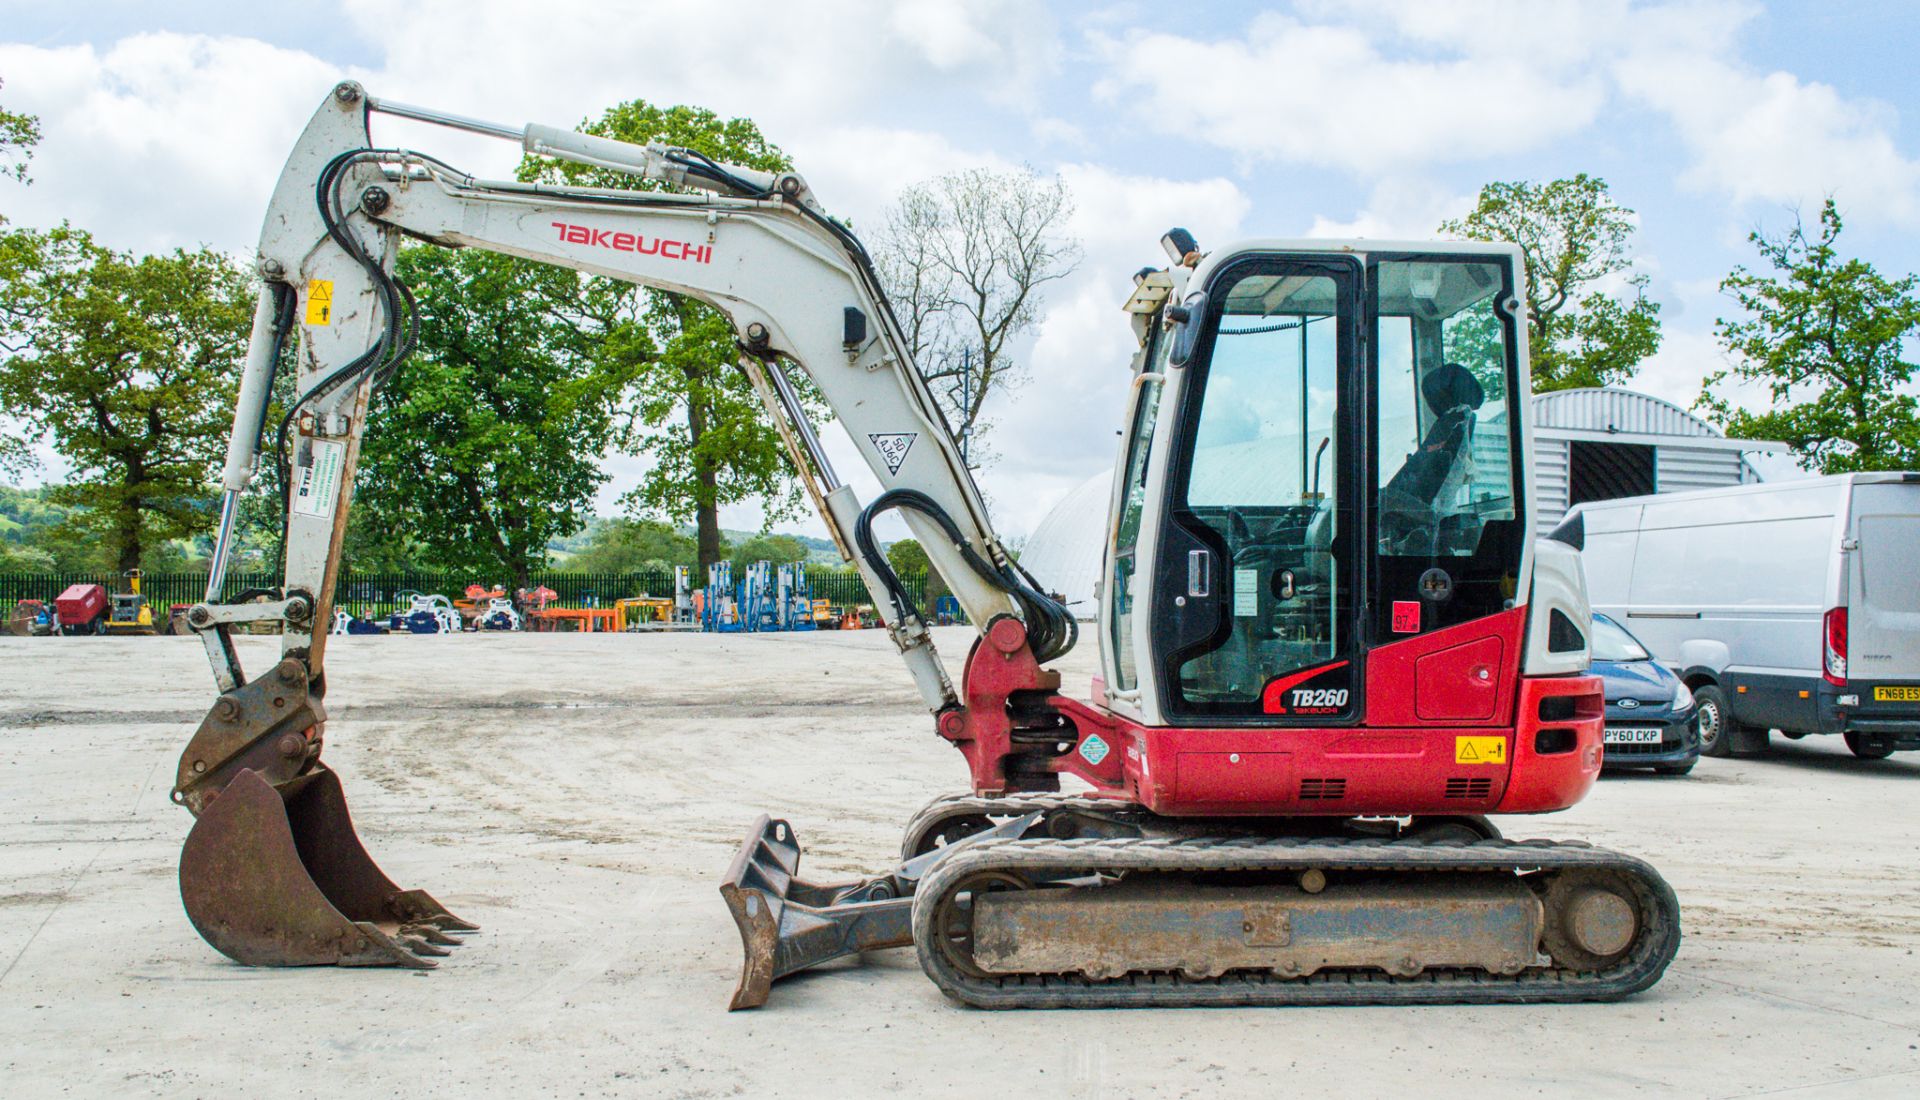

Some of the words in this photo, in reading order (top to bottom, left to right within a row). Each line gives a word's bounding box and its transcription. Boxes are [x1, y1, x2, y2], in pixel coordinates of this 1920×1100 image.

[1292, 688, 1349, 707] TB260
[1878, 688, 1905, 699] FN68
[1906, 688, 1920, 699] ES
[1604, 730, 1634, 742] PY60
[1636, 730, 1658, 742] CKP
